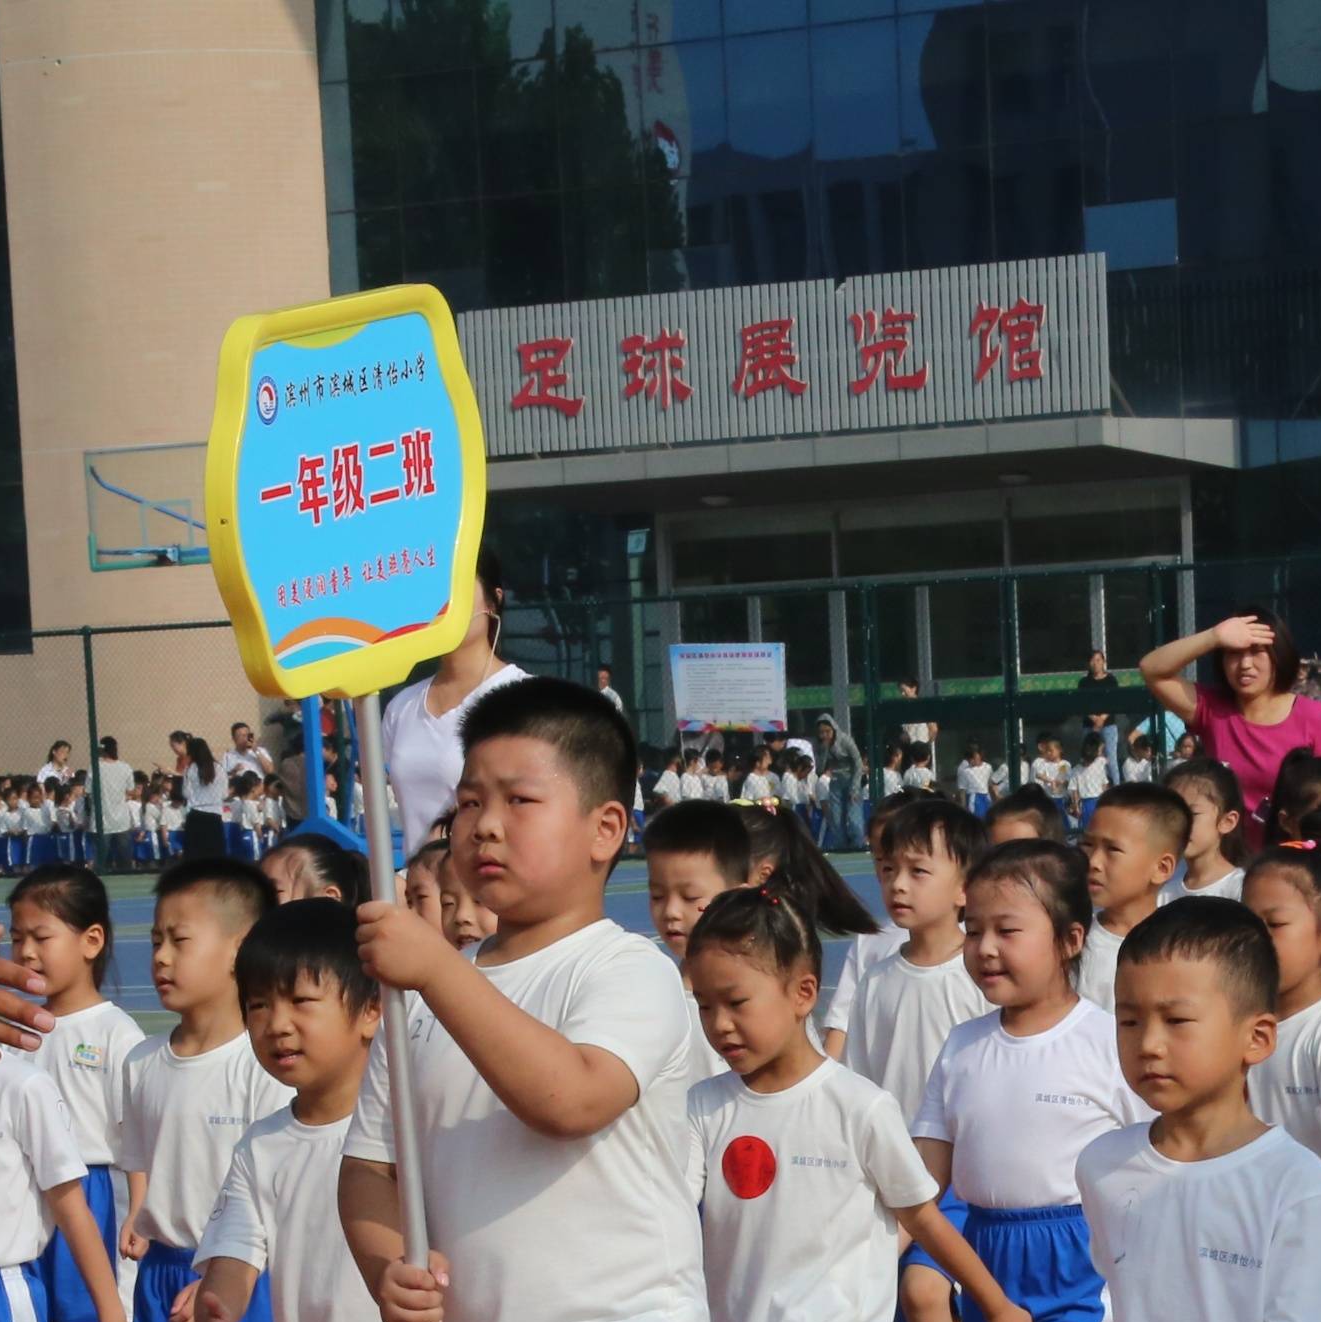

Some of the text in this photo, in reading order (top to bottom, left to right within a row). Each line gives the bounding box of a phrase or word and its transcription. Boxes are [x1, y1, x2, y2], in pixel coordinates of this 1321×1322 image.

[284, 351, 426, 408] 滨州市滨城区清怡小学
[511, 297, 1047, 419] 足球展览馆
[259, 427, 436, 528] 一年级二班
